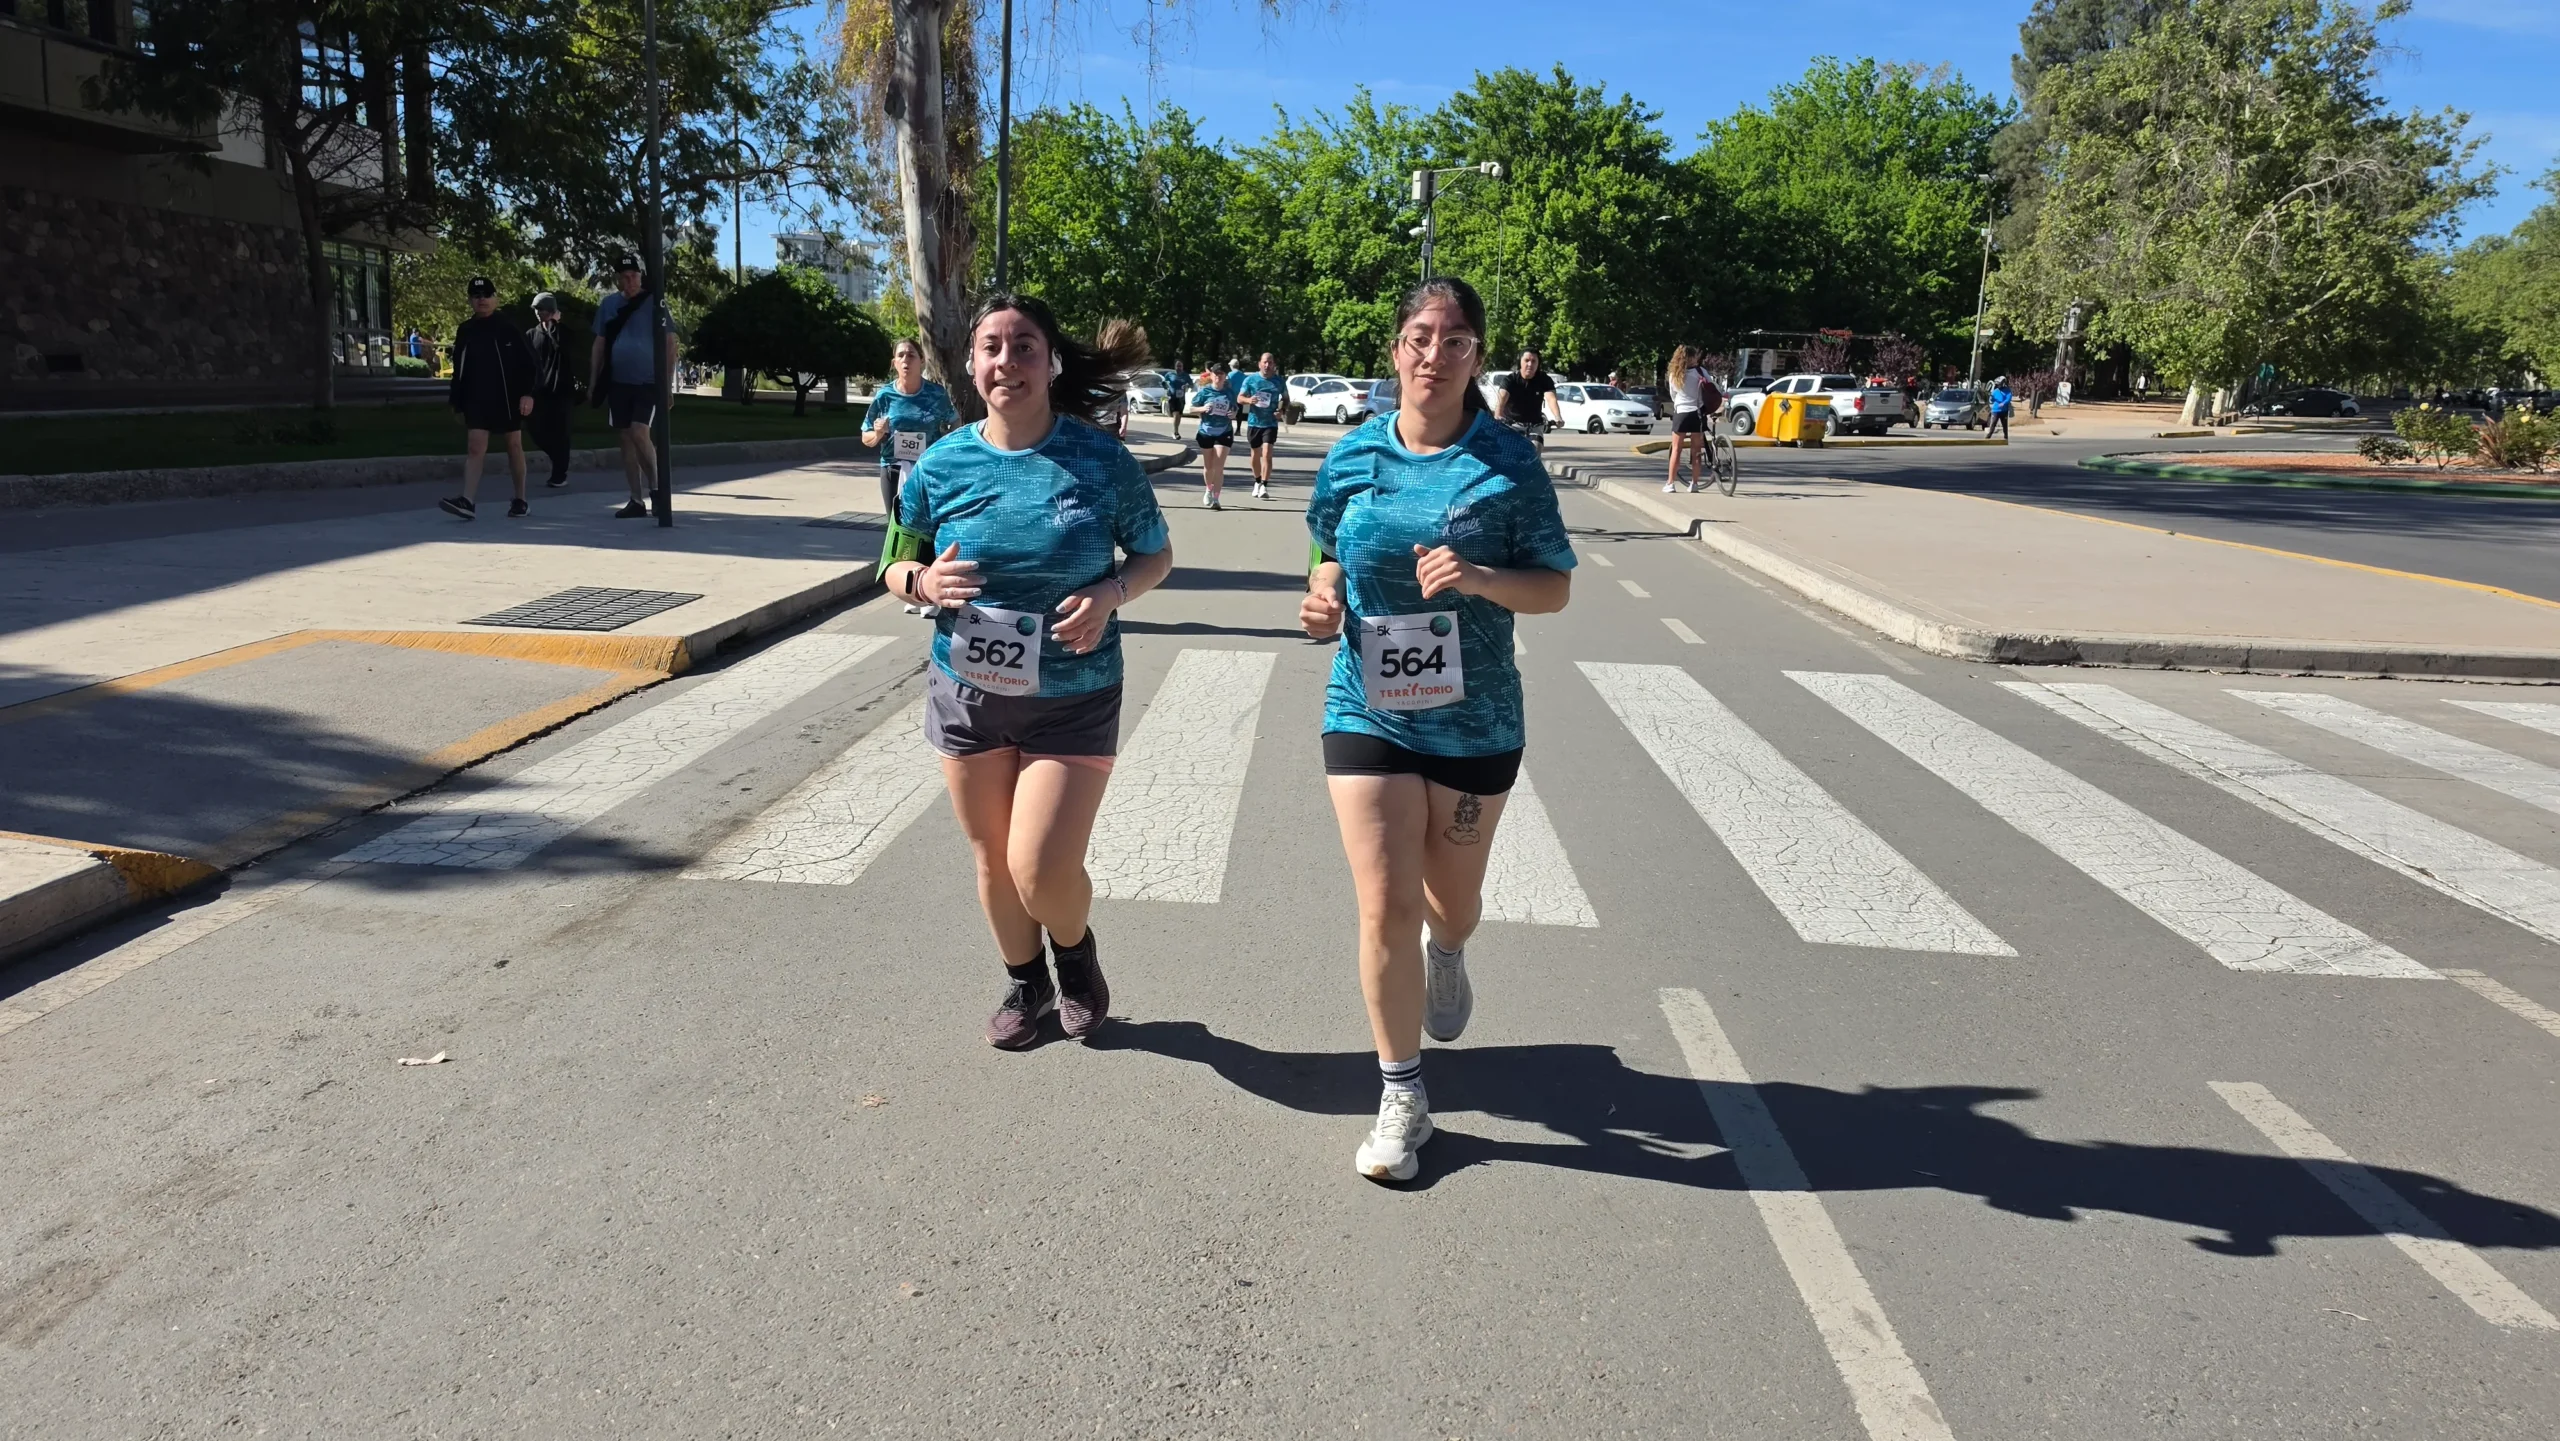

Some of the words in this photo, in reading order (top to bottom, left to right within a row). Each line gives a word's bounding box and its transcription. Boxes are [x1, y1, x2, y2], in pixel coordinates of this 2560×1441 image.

[661, 317, 667, 327] 2
[901, 439, 920, 450] 581
[1054, 514, 1062, 526] a
[1442, 524, 1451, 537] a
[969, 614, 982, 625] 5k
[1377, 625, 1391, 636] 5k
[965, 636, 1026, 670] 562
[1379, 645, 1447, 679] 564
